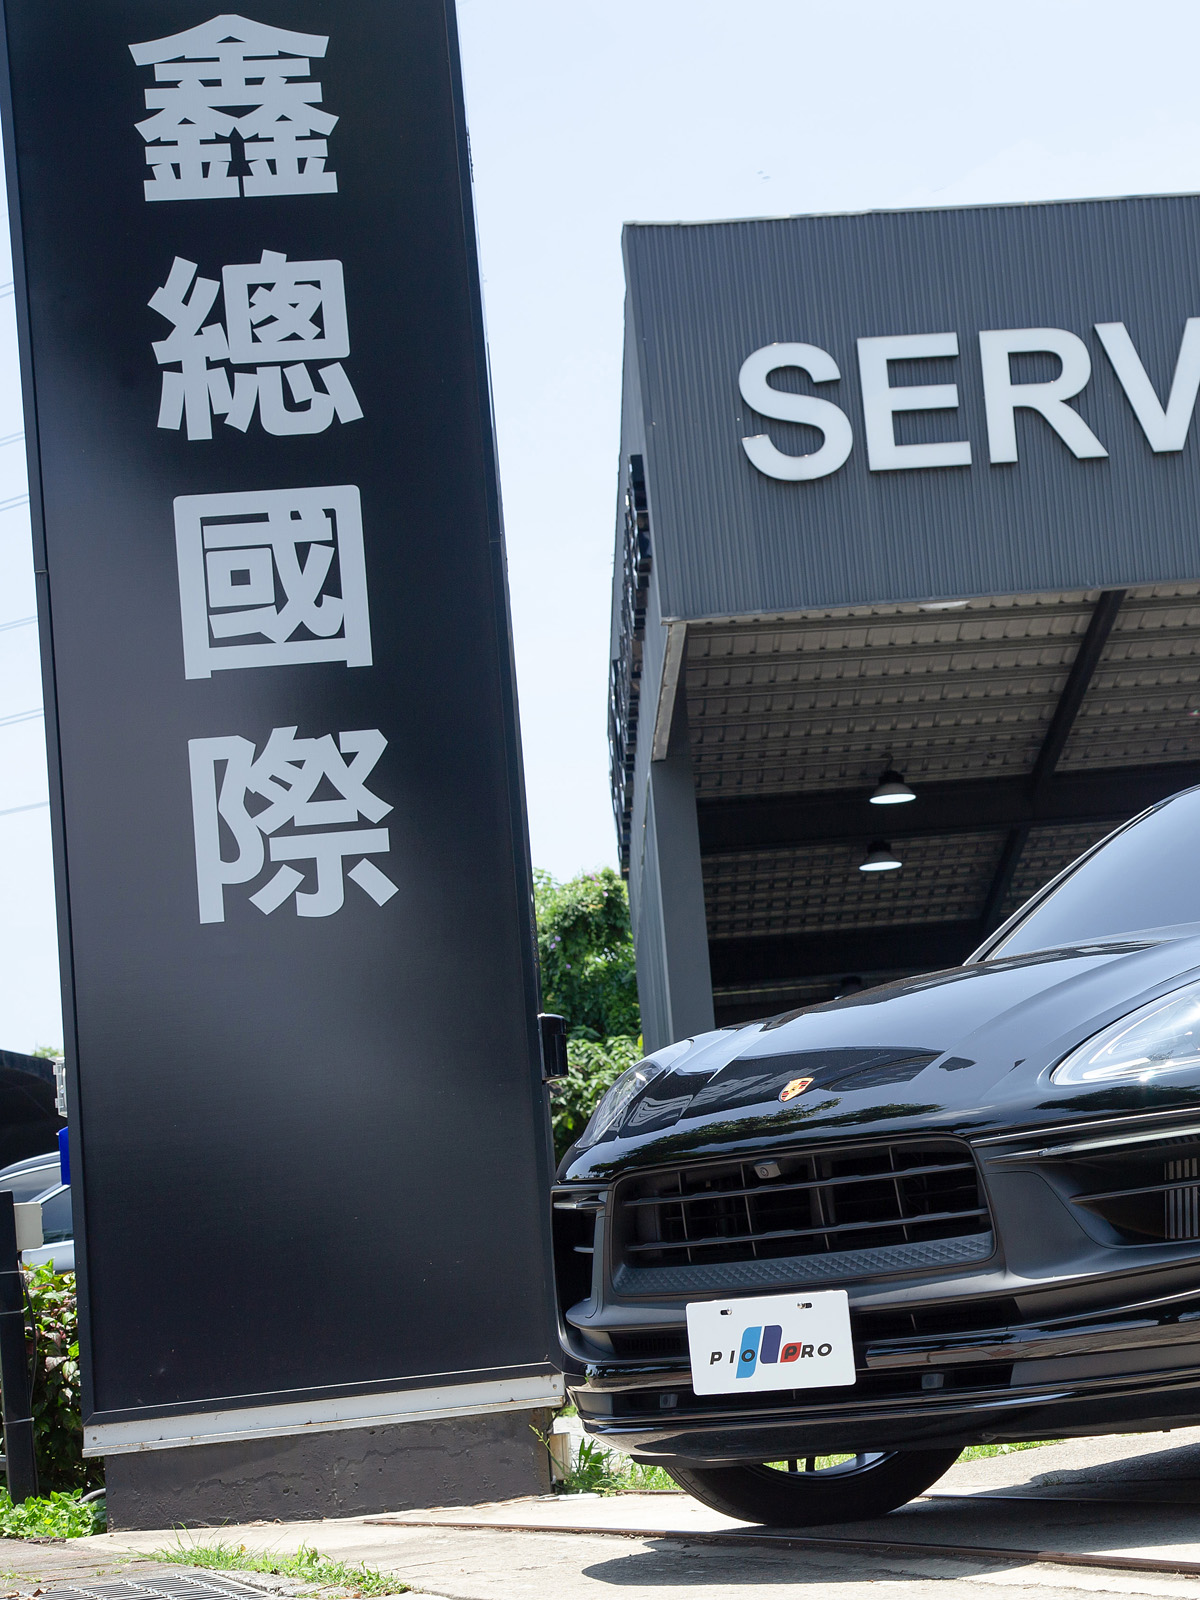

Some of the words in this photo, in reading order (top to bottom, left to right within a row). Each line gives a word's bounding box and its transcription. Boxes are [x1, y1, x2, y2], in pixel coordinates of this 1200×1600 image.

[129, 14, 399, 924] 鑫總國際
[709, 1350, 756, 1365] PIO
[783, 1343, 833, 1360] PRO
